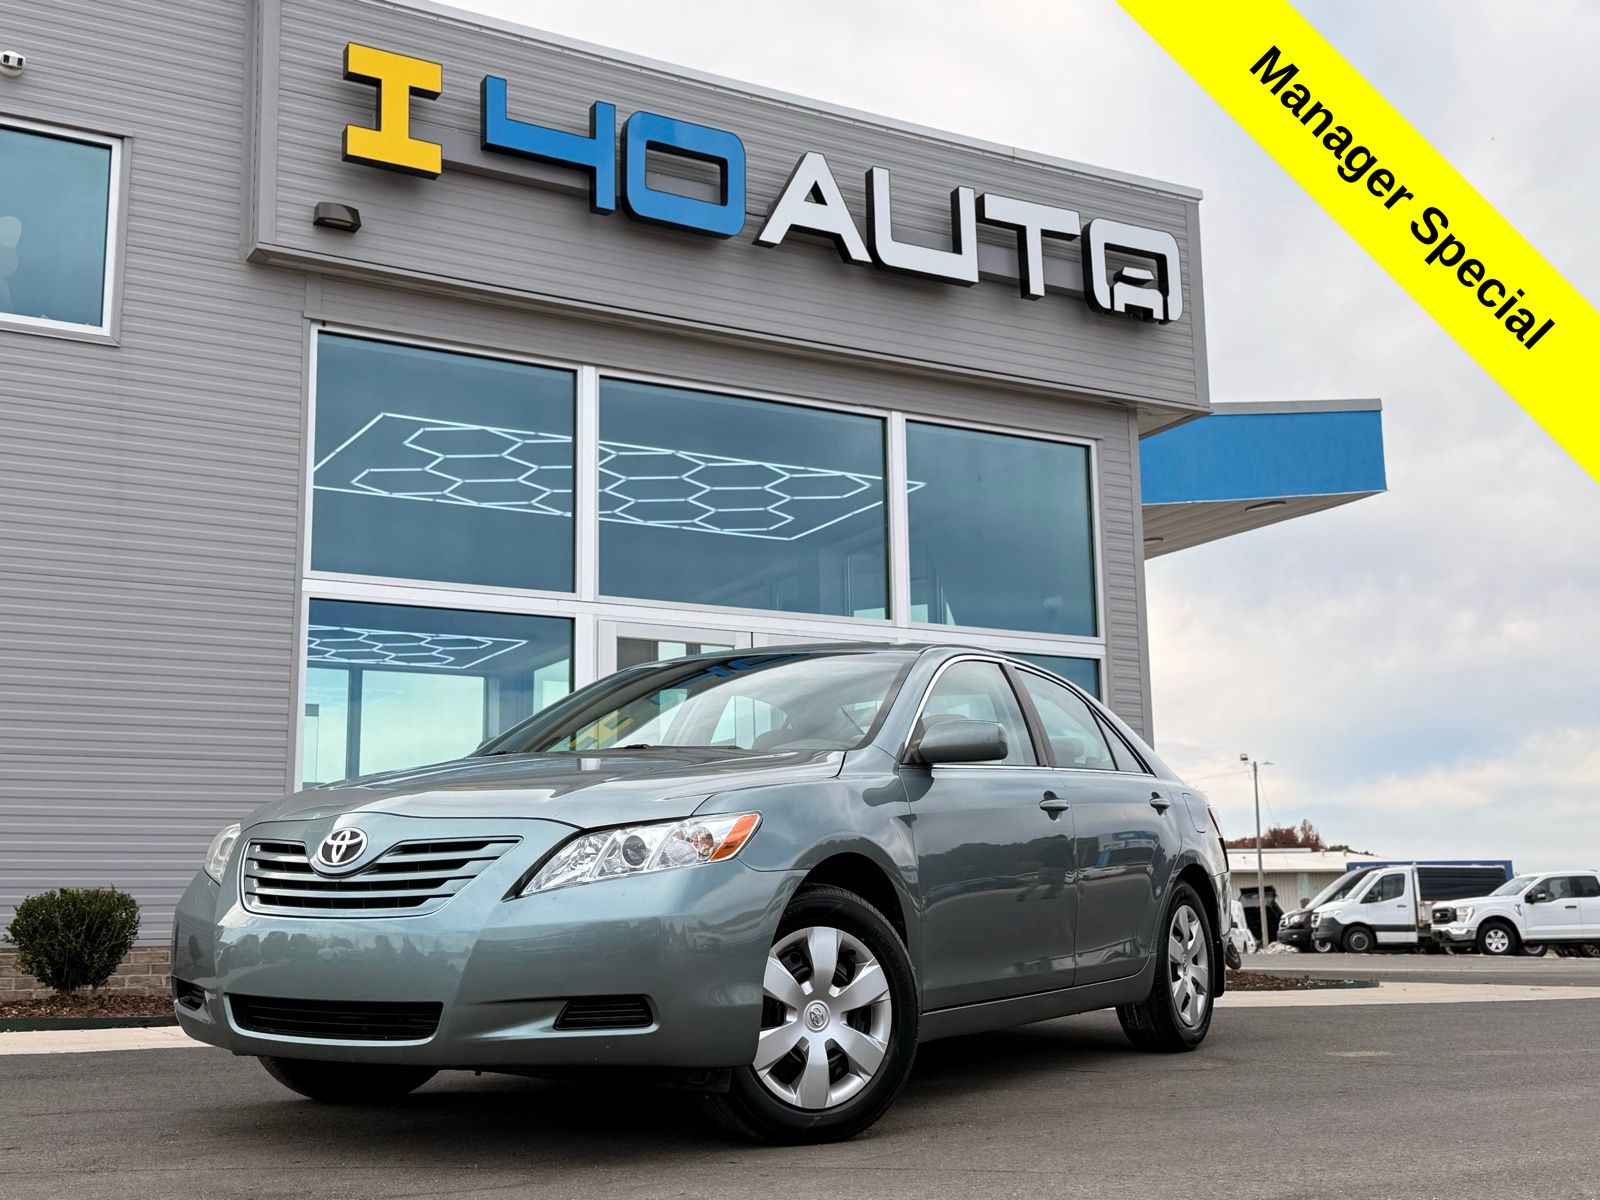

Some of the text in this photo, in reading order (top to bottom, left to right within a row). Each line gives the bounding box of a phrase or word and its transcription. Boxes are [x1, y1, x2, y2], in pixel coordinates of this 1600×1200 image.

[343, 42, 1183, 324] I 40 AUTO
